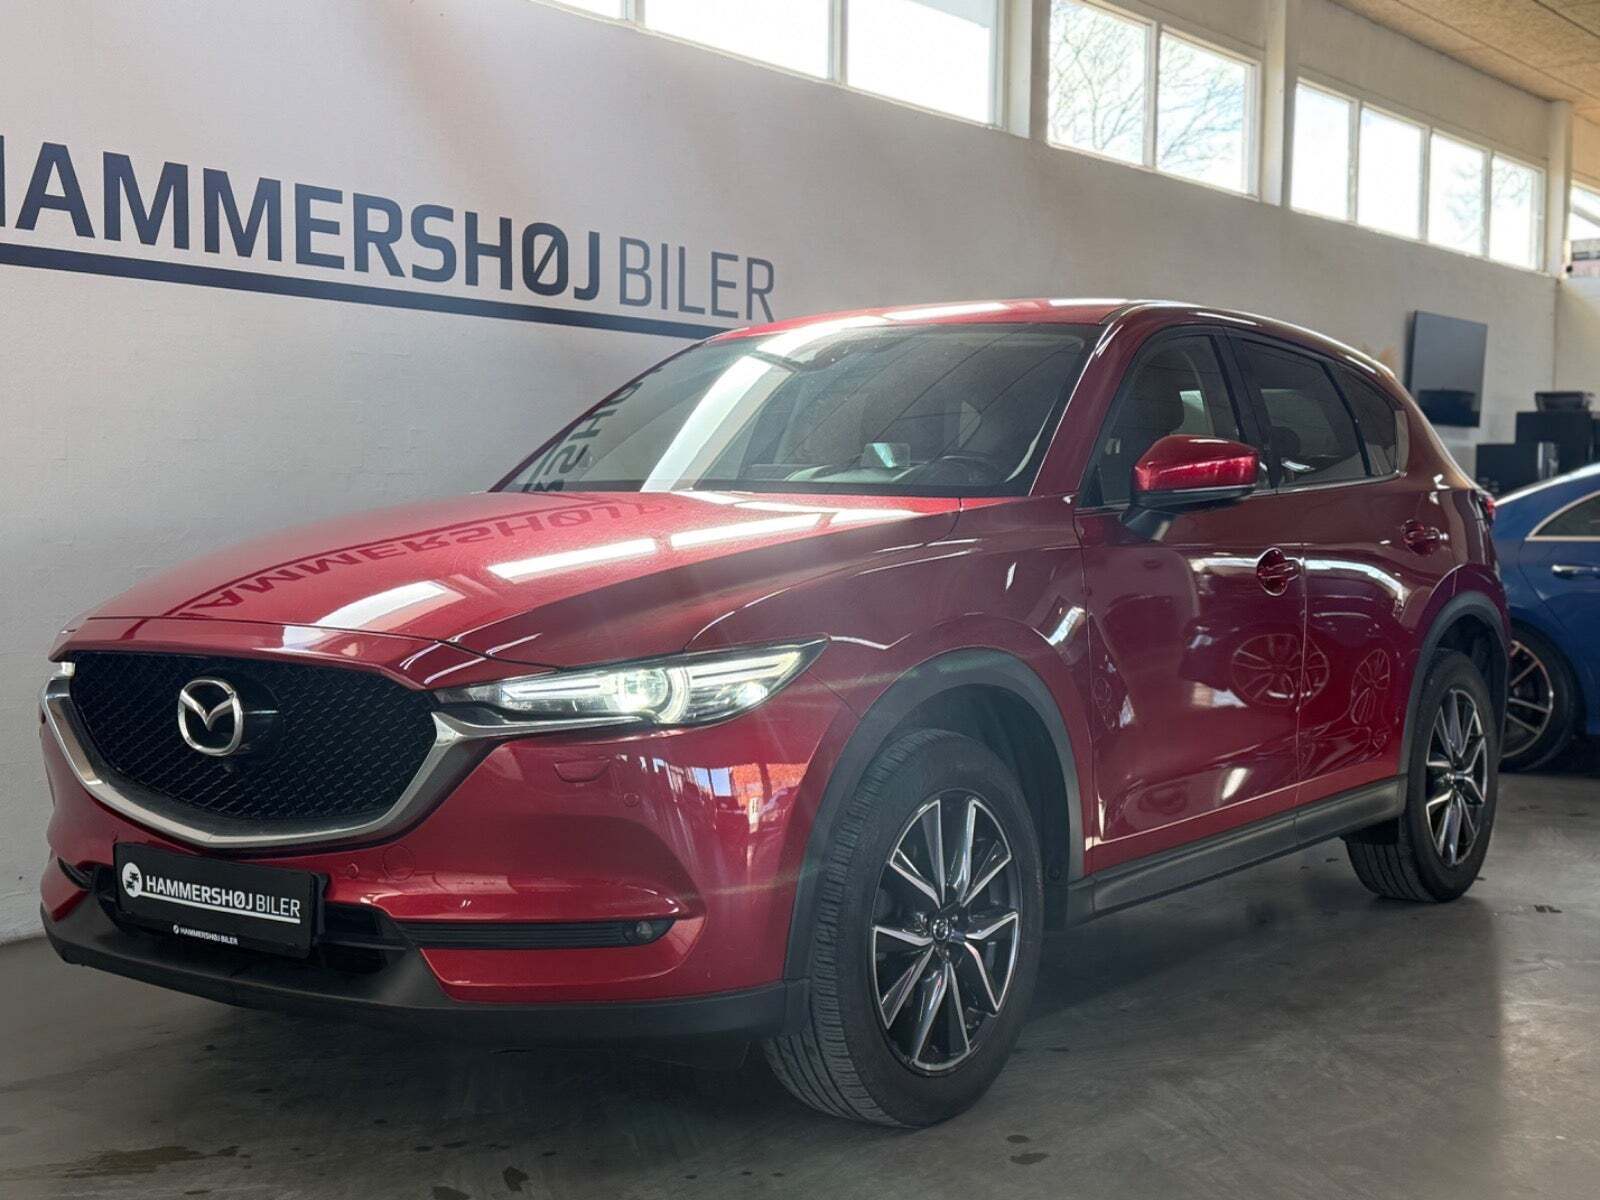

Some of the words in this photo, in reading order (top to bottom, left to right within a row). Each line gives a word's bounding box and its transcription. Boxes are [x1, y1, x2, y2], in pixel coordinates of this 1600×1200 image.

[619, 236, 774, 322] BILER
[146, 875, 252, 910] HAMMERSHØJ
[256, 894, 300, 917] BILER
